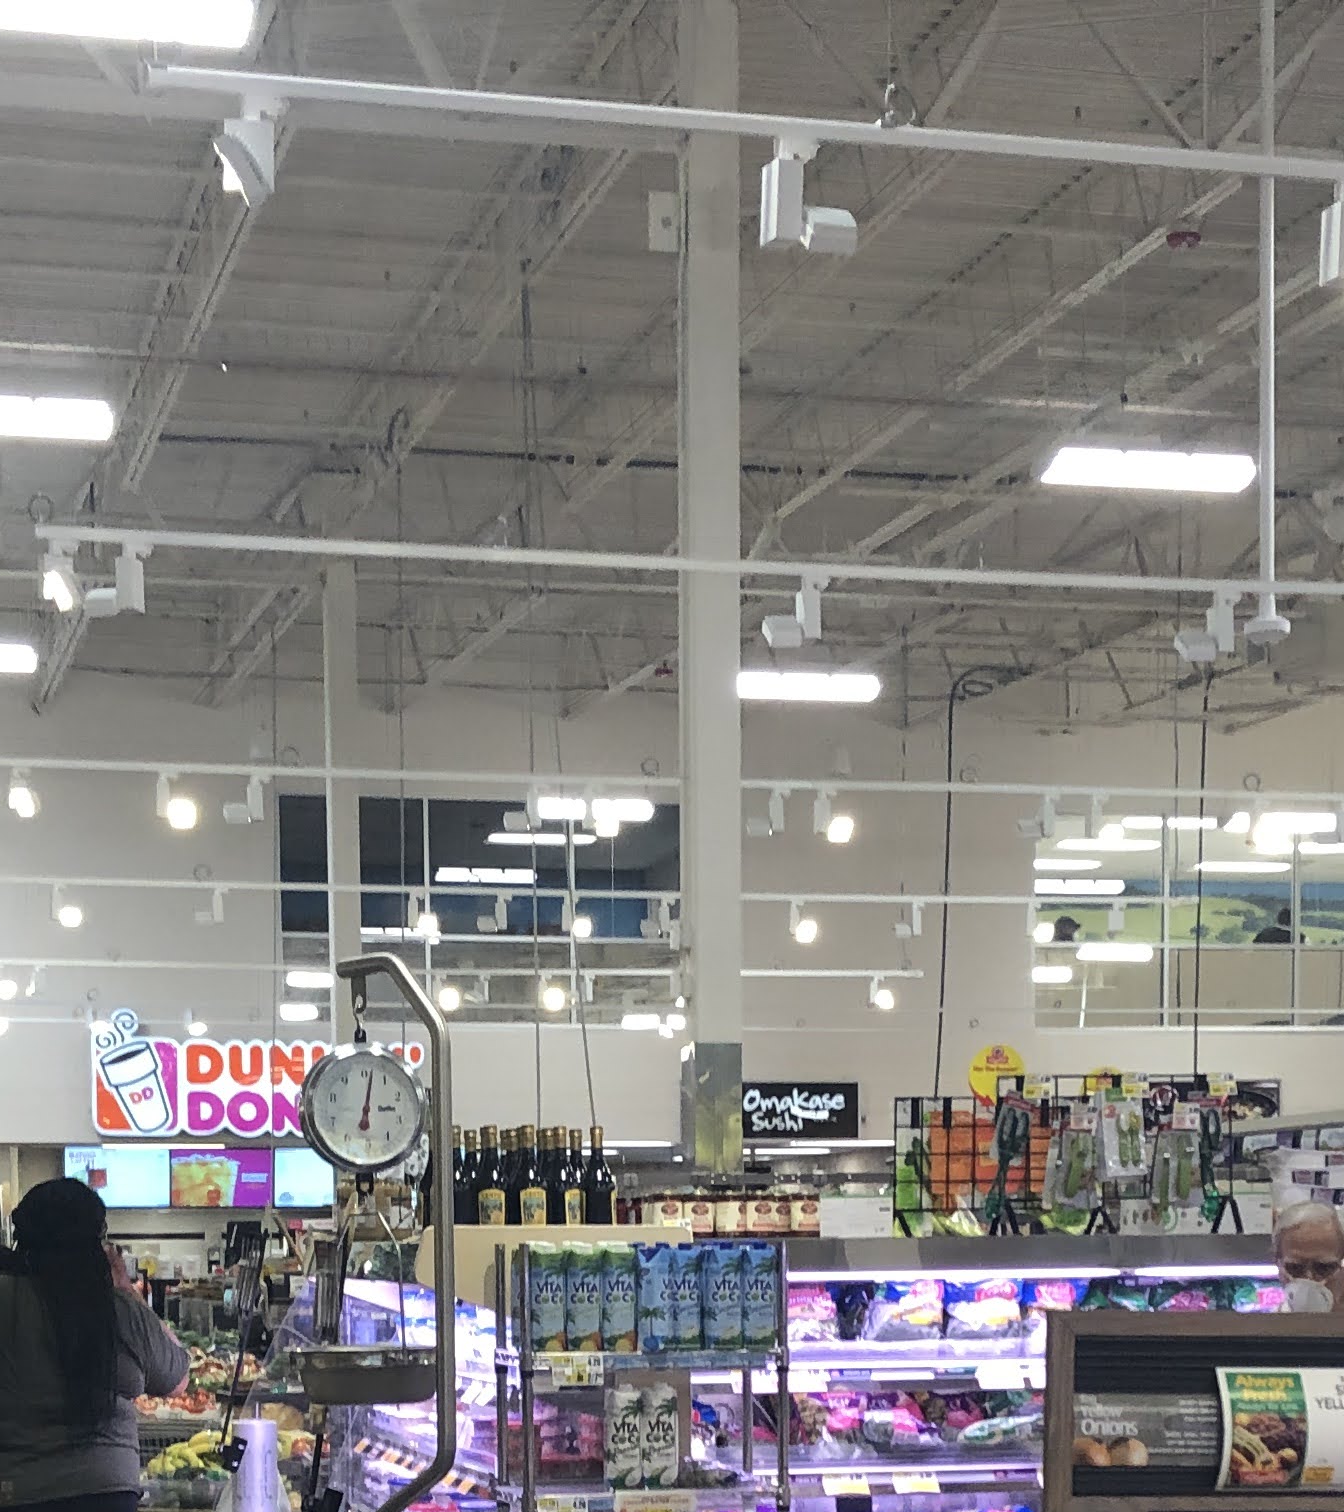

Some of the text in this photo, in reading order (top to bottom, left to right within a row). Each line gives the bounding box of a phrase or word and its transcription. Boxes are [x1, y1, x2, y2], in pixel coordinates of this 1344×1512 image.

[752, 1111, 803, 1132] Sushi
[536, 1281, 562, 1293] VITA
[572, 1281, 598, 1293] VITA
[607, 1279, 633, 1292] VITA
[714, 1278, 740, 1291] VITA
[747, 1278, 772, 1291] VITA
[613, 1420, 639, 1434] VITA
[648, 1419, 674, 1433] VITA
[1081, 1419, 1138, 1436] Onions
